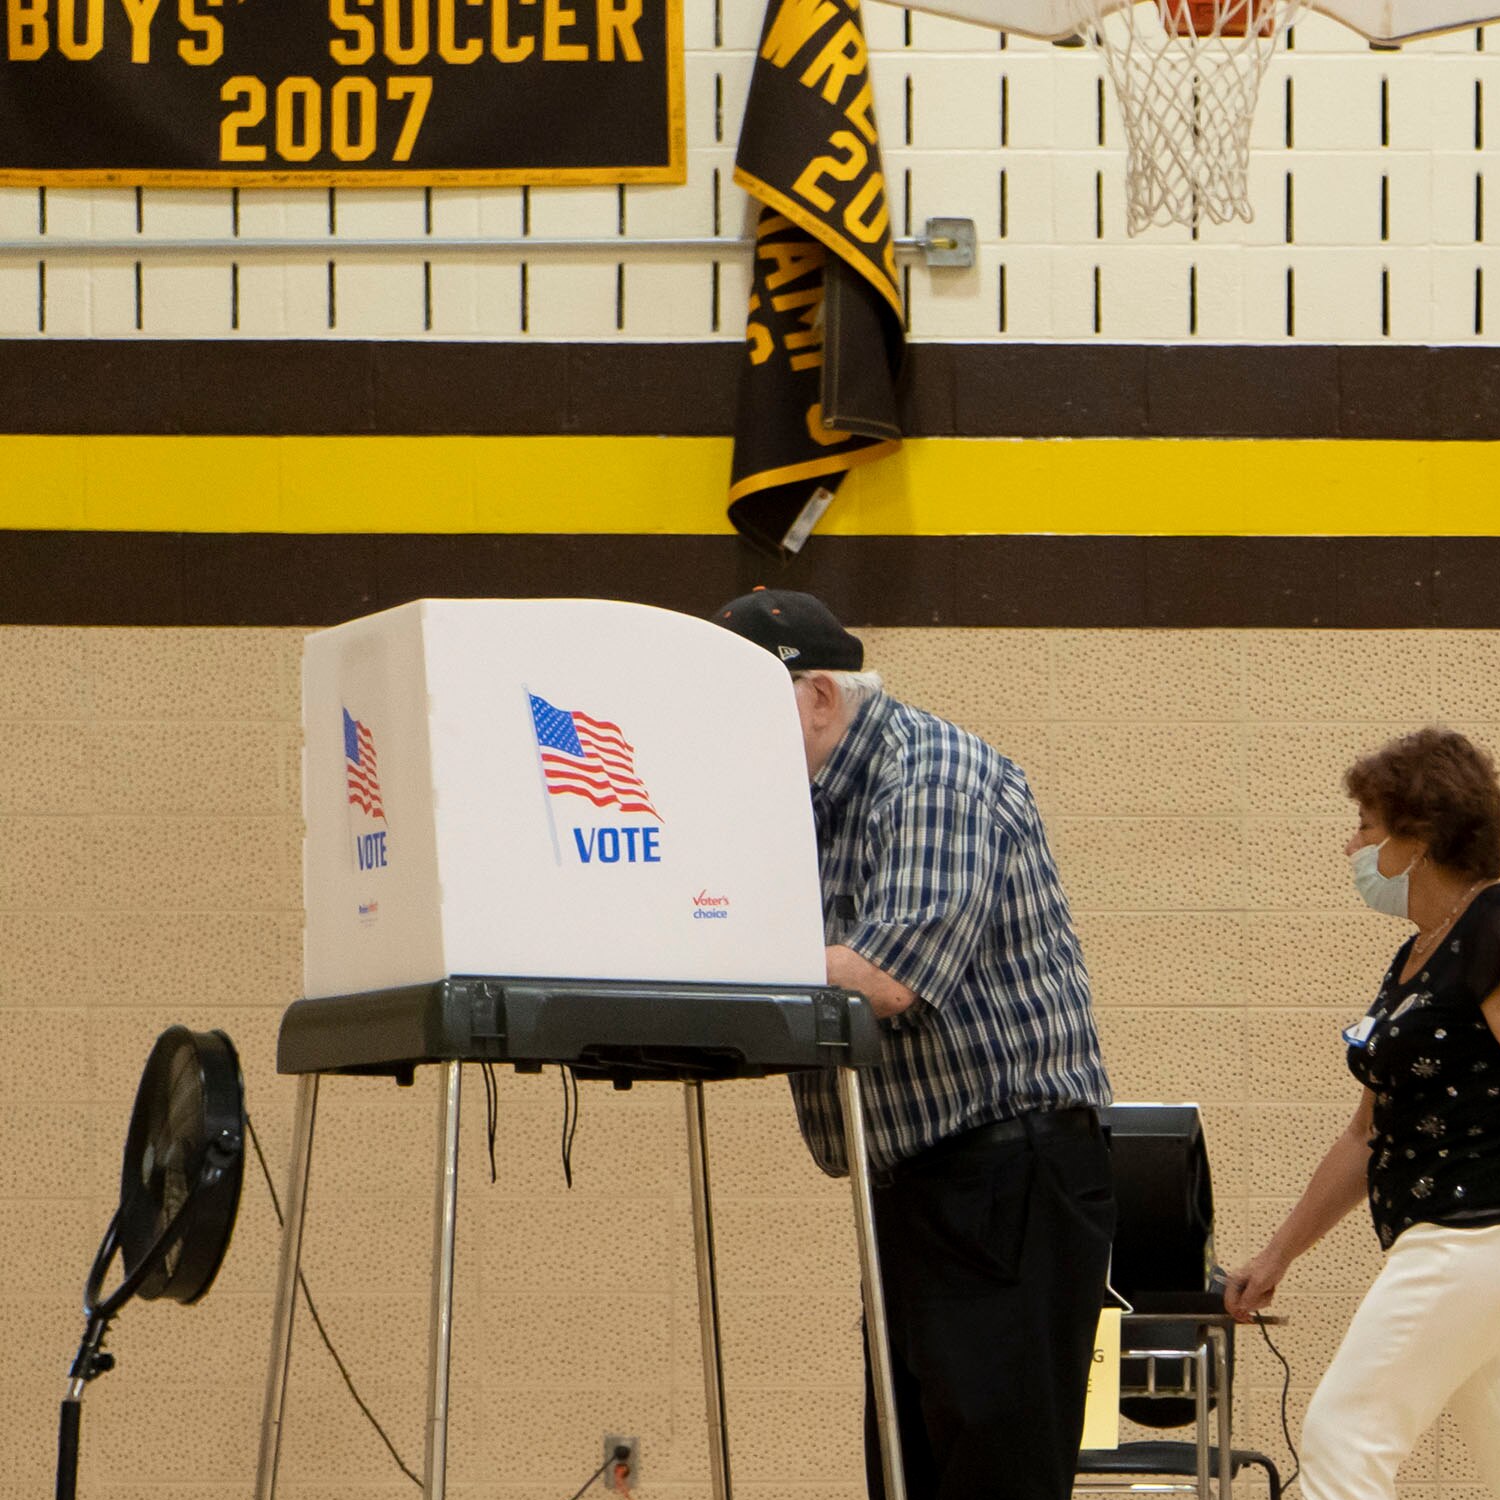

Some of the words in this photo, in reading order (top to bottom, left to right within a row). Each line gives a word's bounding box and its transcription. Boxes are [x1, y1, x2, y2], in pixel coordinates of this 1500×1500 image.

[8, 0, 246, 66] BOYS
[329, 0, 643, 66] SOCCER
[219, 75, 433, 162] 2007
[790, 130, 900, 285] 20
[357, 831, 387, 871] VOTE
[573, 827, 661, 863] VOTE
[693, 908, 728, 919] choice
